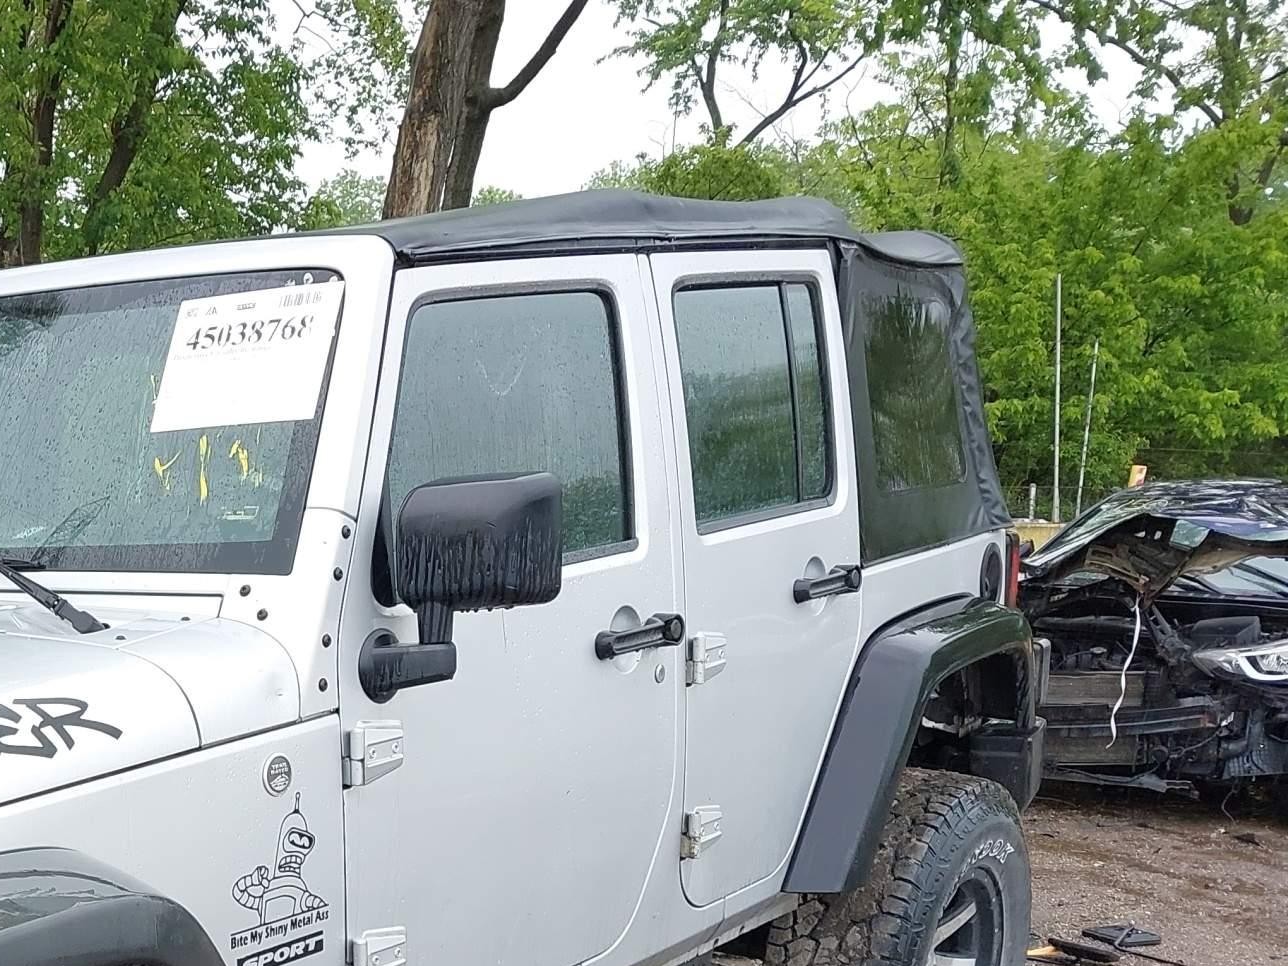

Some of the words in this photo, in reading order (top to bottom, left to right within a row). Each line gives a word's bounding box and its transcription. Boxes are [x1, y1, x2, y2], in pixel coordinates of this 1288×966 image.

[186, 314, 315, 351] 45038768
[230, 936, 249, 950] Bite
[250, 930, 264, 945] My
[265, 922, 289, 938] Shiny
[290, 914, 313, 931] Metal
[315, 910, 329, 924] Ass
